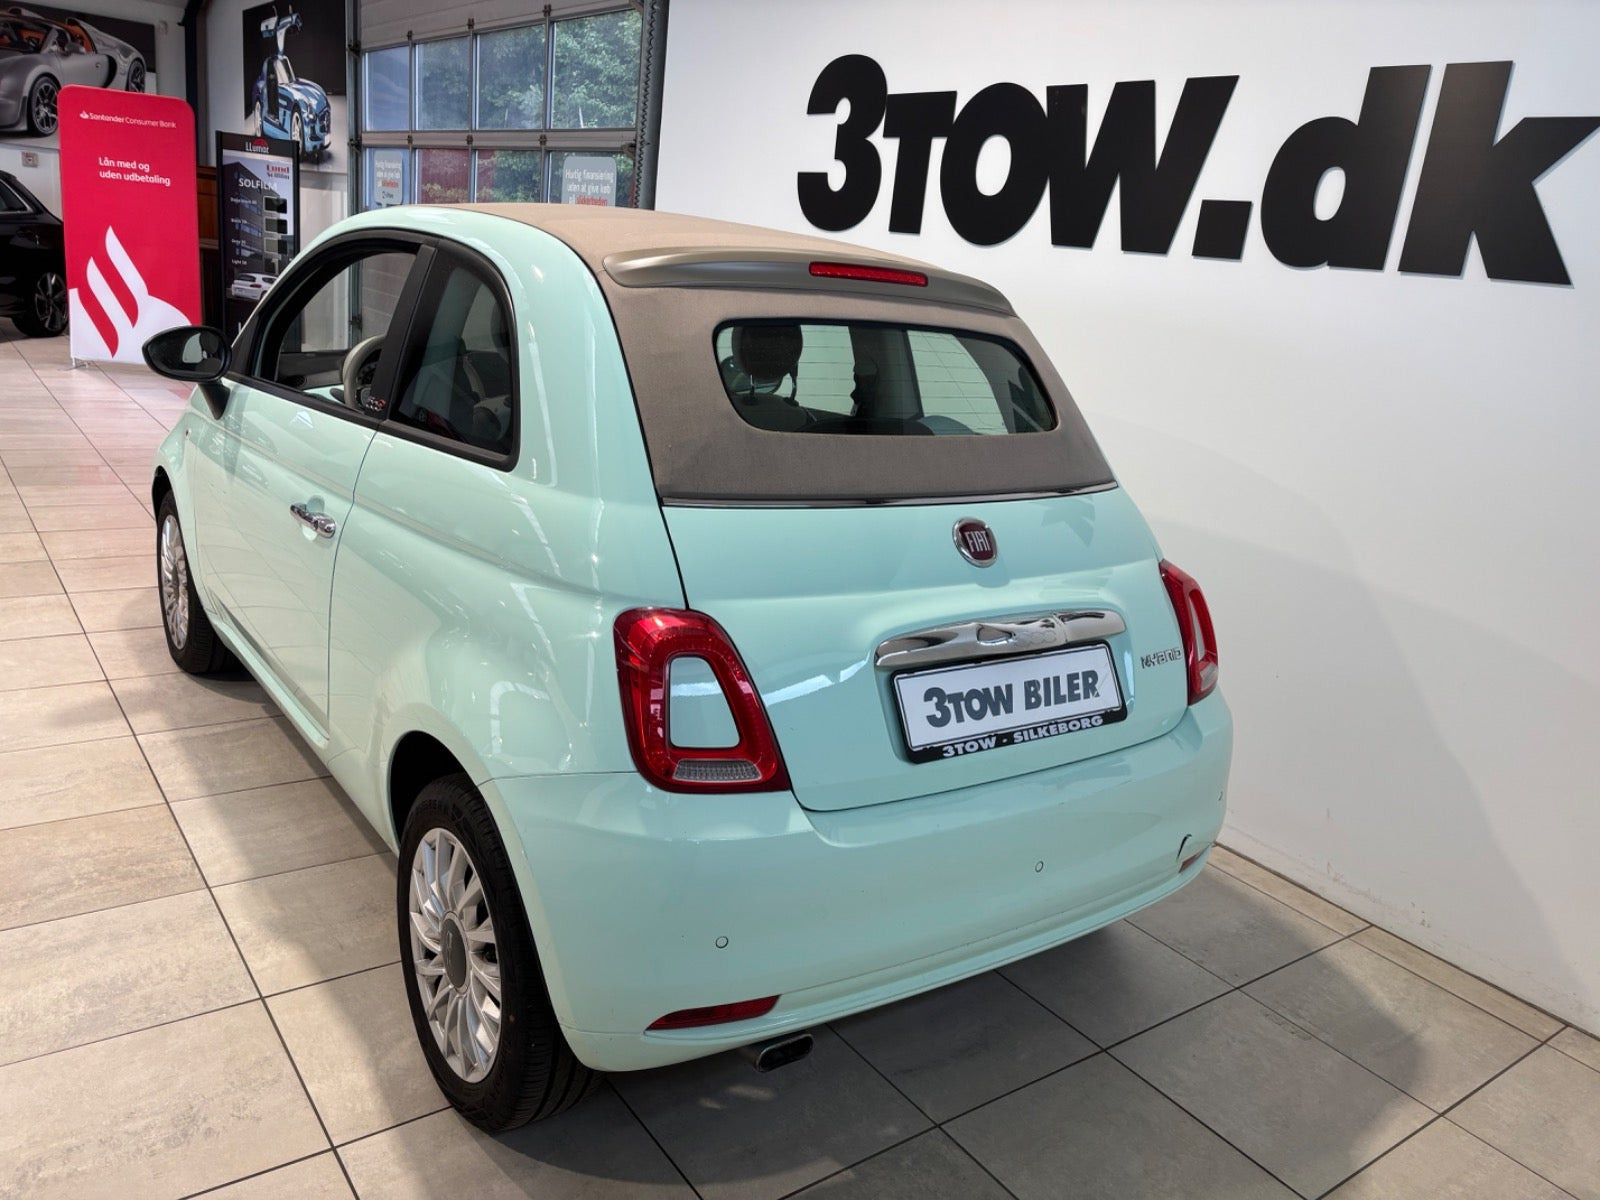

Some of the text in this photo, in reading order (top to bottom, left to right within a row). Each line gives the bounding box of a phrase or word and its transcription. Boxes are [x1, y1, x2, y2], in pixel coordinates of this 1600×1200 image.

[89, 112, 176, 129] Santander Consumer Bank
[98, 156, 150, 172] Lån med og
[797, 53, 1600, 286] 3TOW.dk
[99, 169, 171, 187] uden udbetaling
[238, 177, 278, 191] SOLFILM
[964, 530, 991, 553] FIAT
[923, 670, 1100, 728] 3TOW BILER
[942, 736, 997, 758] 3TOW
[1013, 715, 1104, 744] SILKEBORG
